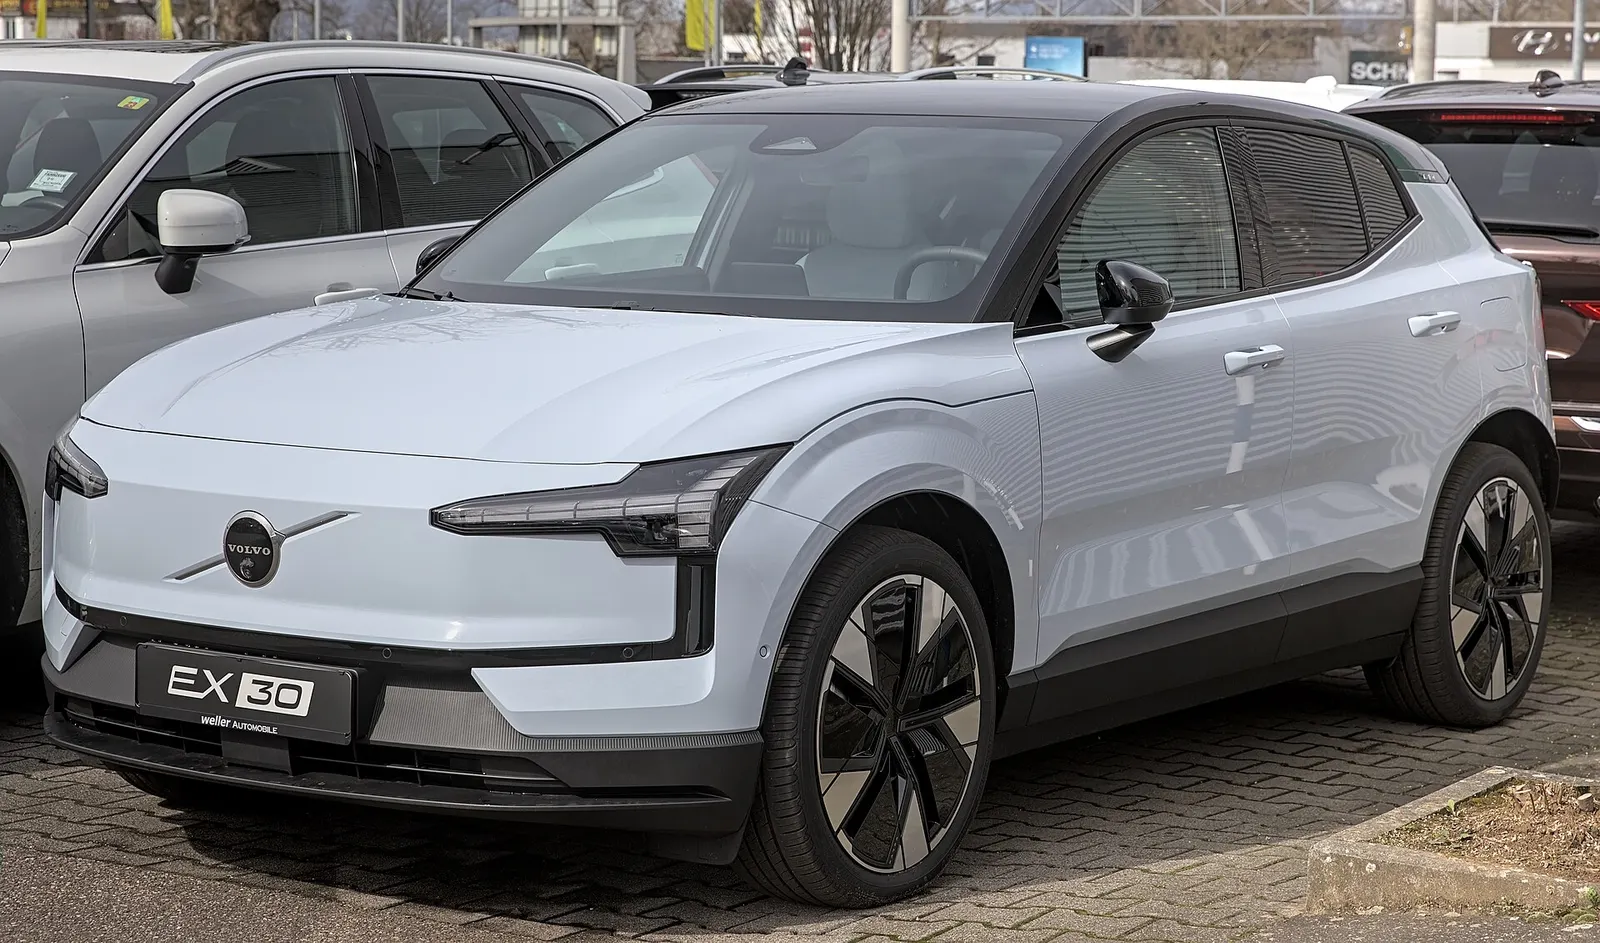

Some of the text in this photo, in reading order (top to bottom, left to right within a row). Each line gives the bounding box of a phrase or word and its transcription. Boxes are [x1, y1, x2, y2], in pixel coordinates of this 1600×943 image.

[227, 543, 271, 556] VOLVO
[167, 664, 303, 710] EX 30
[201, 715, 278, 735] weller AUTOMOBILE
